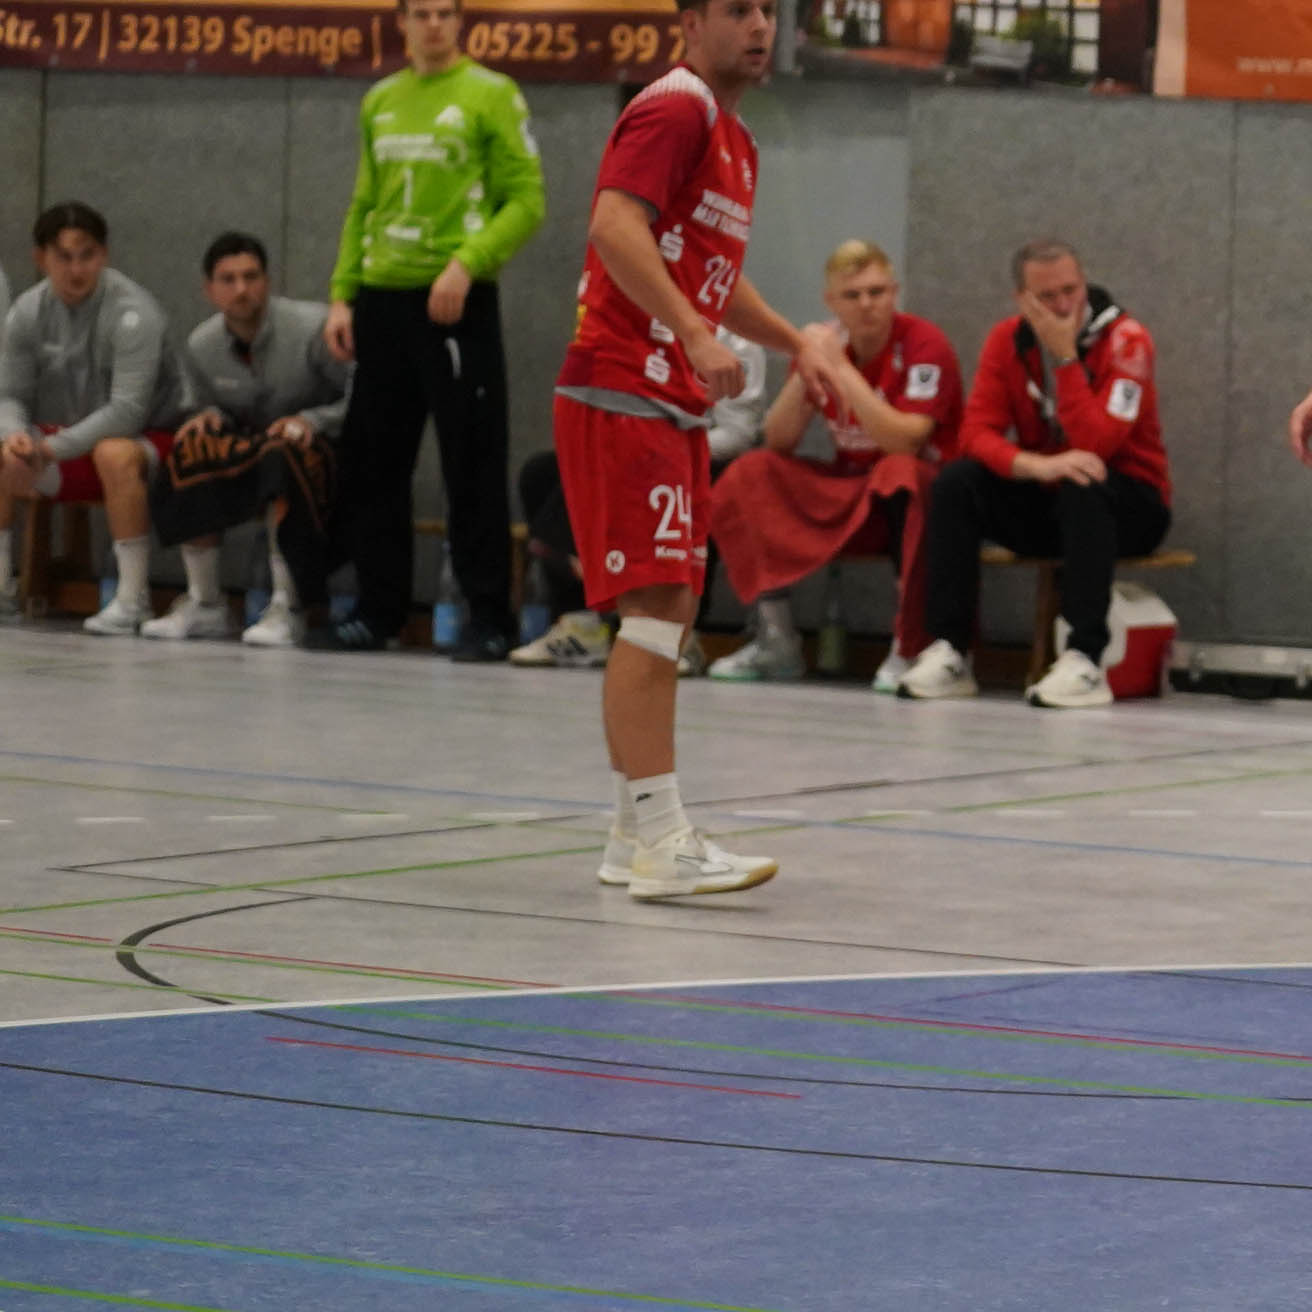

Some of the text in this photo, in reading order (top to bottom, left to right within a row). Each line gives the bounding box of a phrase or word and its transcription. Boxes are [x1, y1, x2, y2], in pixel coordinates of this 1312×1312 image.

[53, 12, 93, 49] 17
[116, 14, 225, 55] 32139
[231, 15, 363, 66] Spenge
[465, 22, 578, 61] 05225
[609, 23, 659, 63] 99
[698, 254, 737, 311] 24
[649, 484, 694, 541] 24
